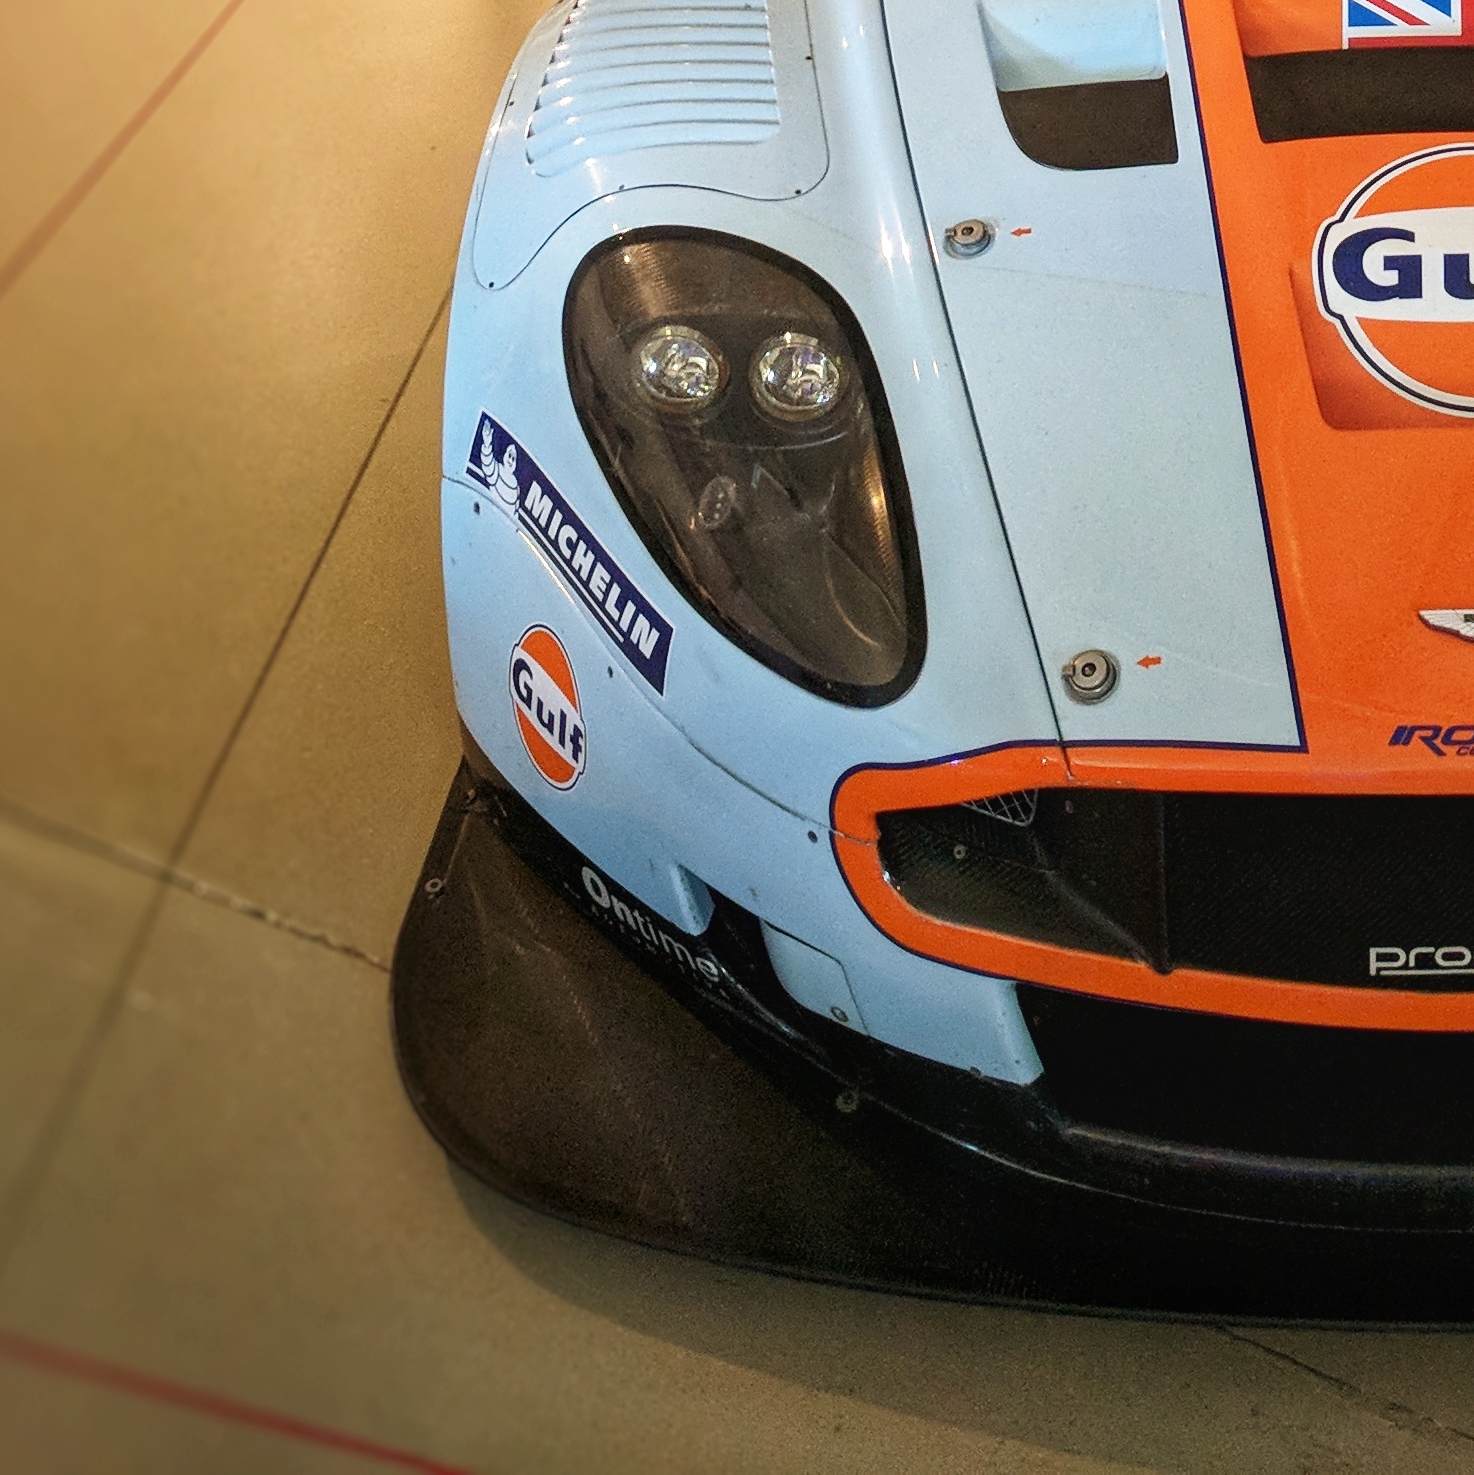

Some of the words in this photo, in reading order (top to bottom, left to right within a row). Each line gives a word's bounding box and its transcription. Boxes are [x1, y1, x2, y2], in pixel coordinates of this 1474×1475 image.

[524, 480, 660, 661] MICHELIN
[511, 657, 584, 764] Gulf
[580, 864, 721, 981] Ontime
